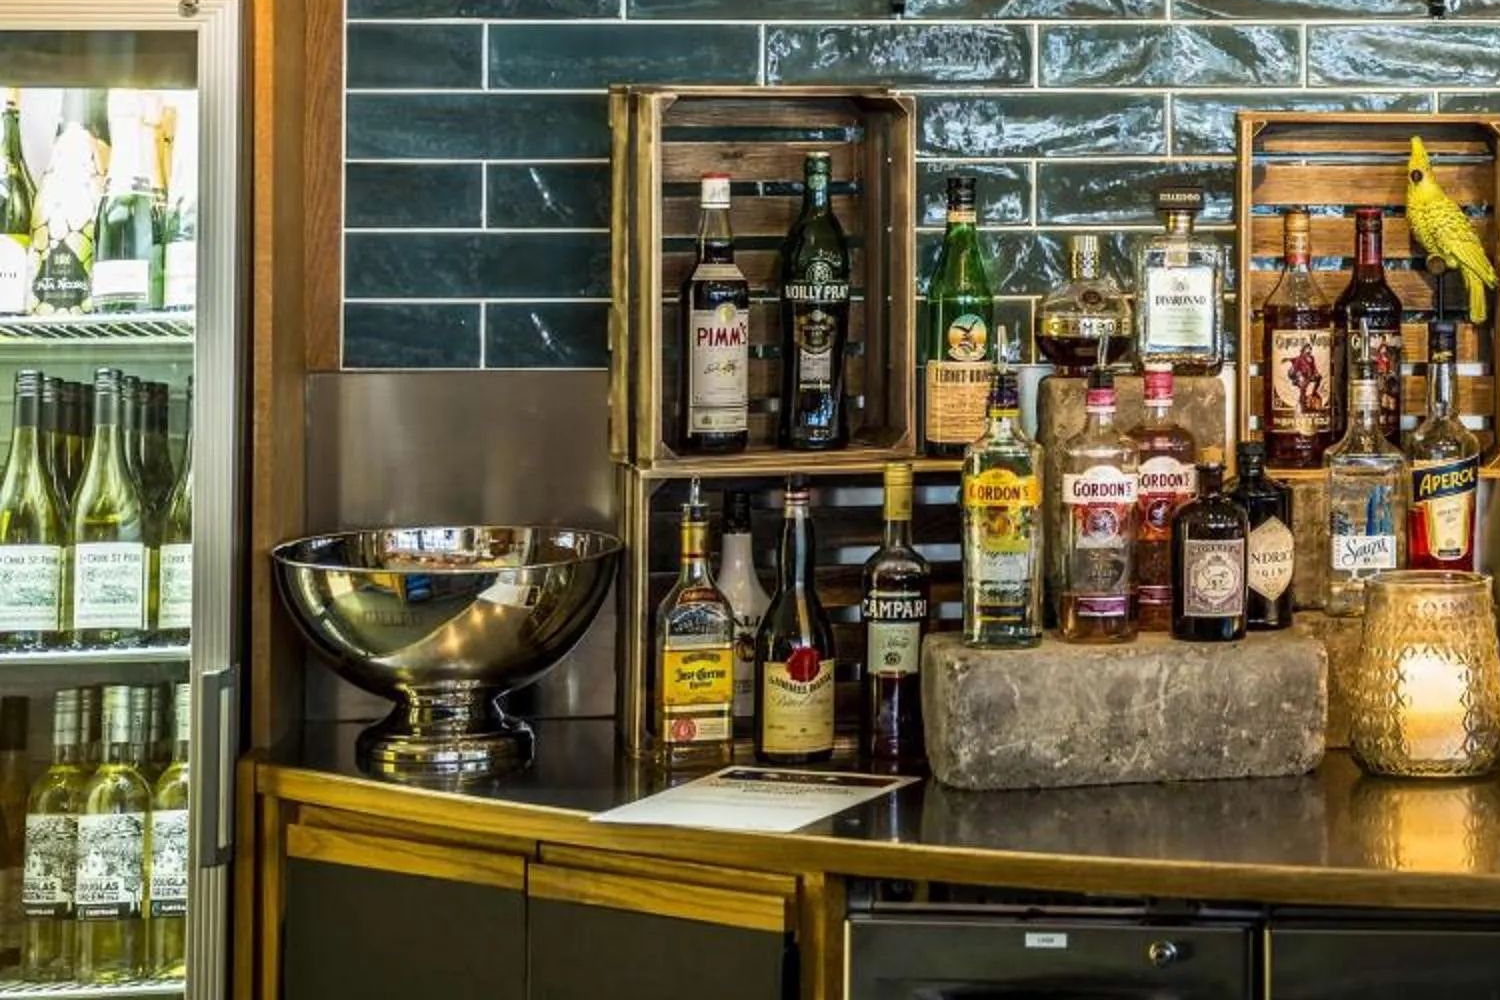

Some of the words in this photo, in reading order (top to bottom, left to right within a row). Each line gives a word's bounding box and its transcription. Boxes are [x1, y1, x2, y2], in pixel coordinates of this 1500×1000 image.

[697, 322, 747, 347] PIMM'S
[1073, 480, 1133, 498] GORDON'S
[1138, 472, 1190, 489] ORDON'S
[969, 485, 1029, 500] GORDON'S
[862, 598, 927, 619] CAMPARI
